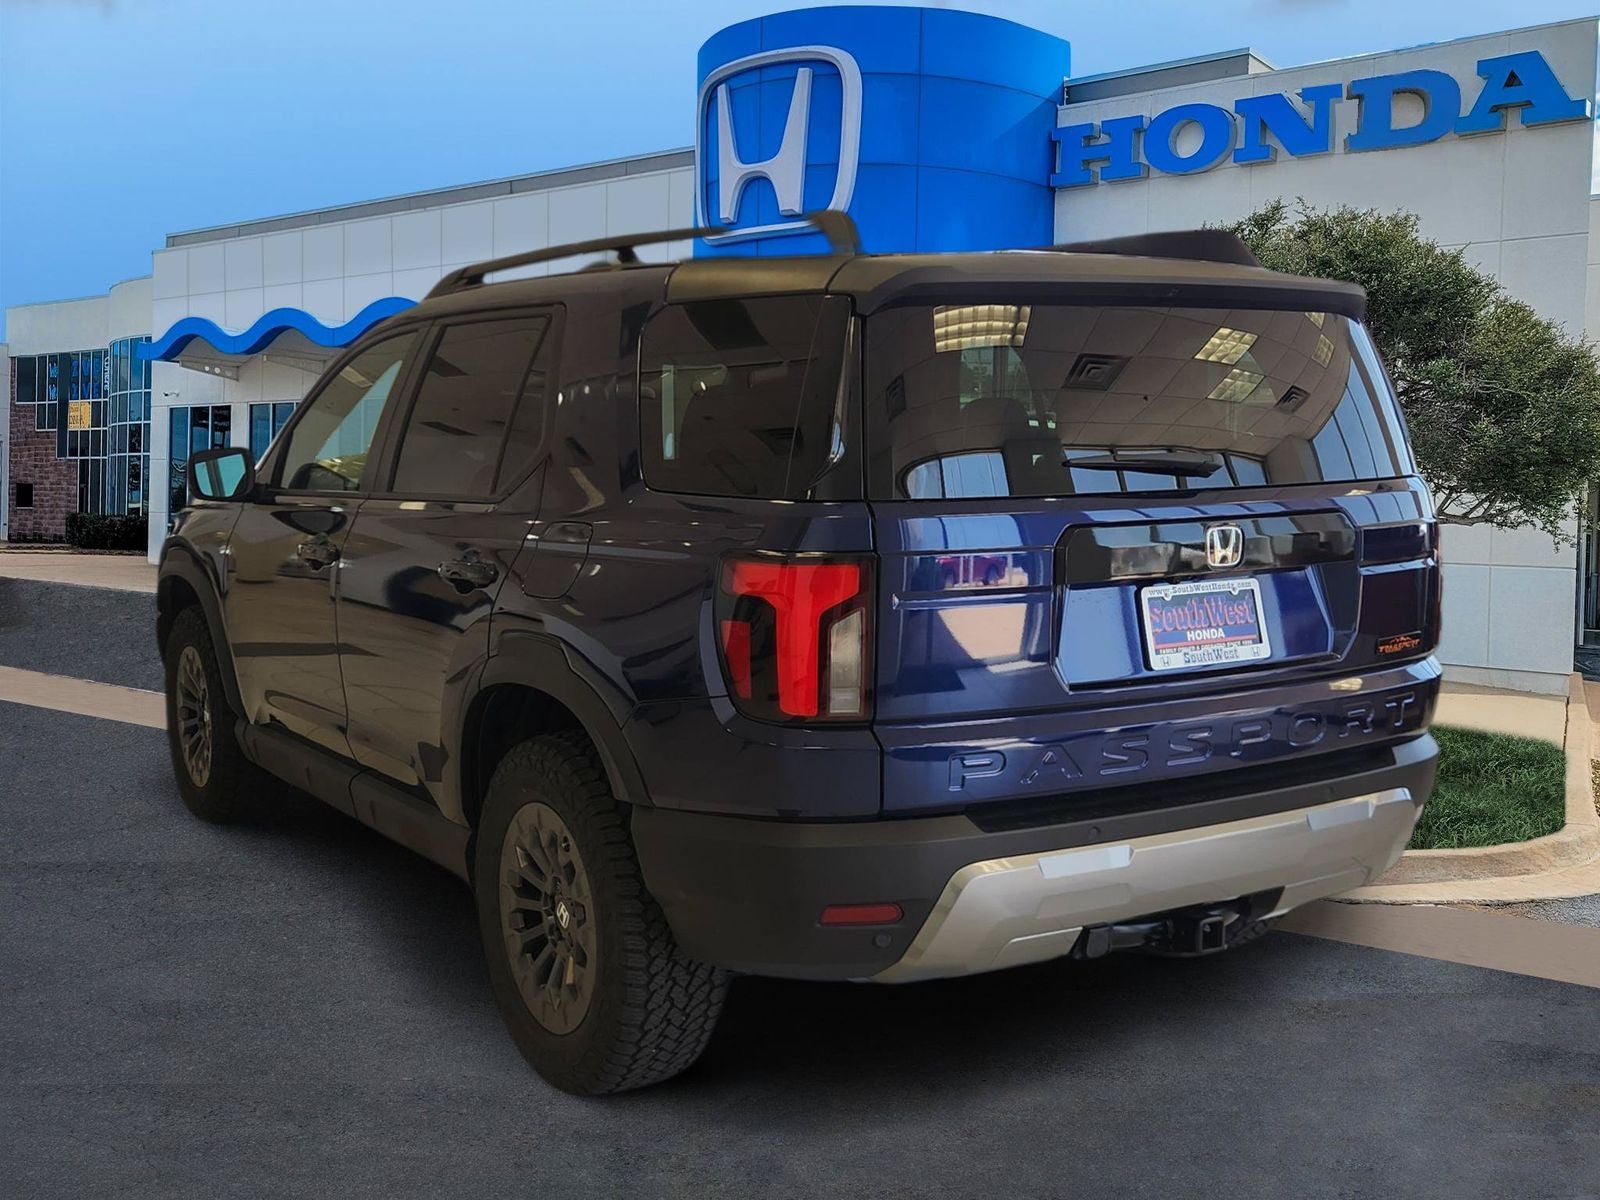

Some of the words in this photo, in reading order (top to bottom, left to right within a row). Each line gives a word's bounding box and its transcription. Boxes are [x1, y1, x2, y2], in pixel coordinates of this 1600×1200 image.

[1050, 50, 1592, 188] HONDA
[1149, 593, 1255, 633] SouthWest
[1186, 627, 1226, 642] HONDA
[1183, 649, 1241, 665] SouthWest
[947, 691, 1418, 793] PASSPORT
